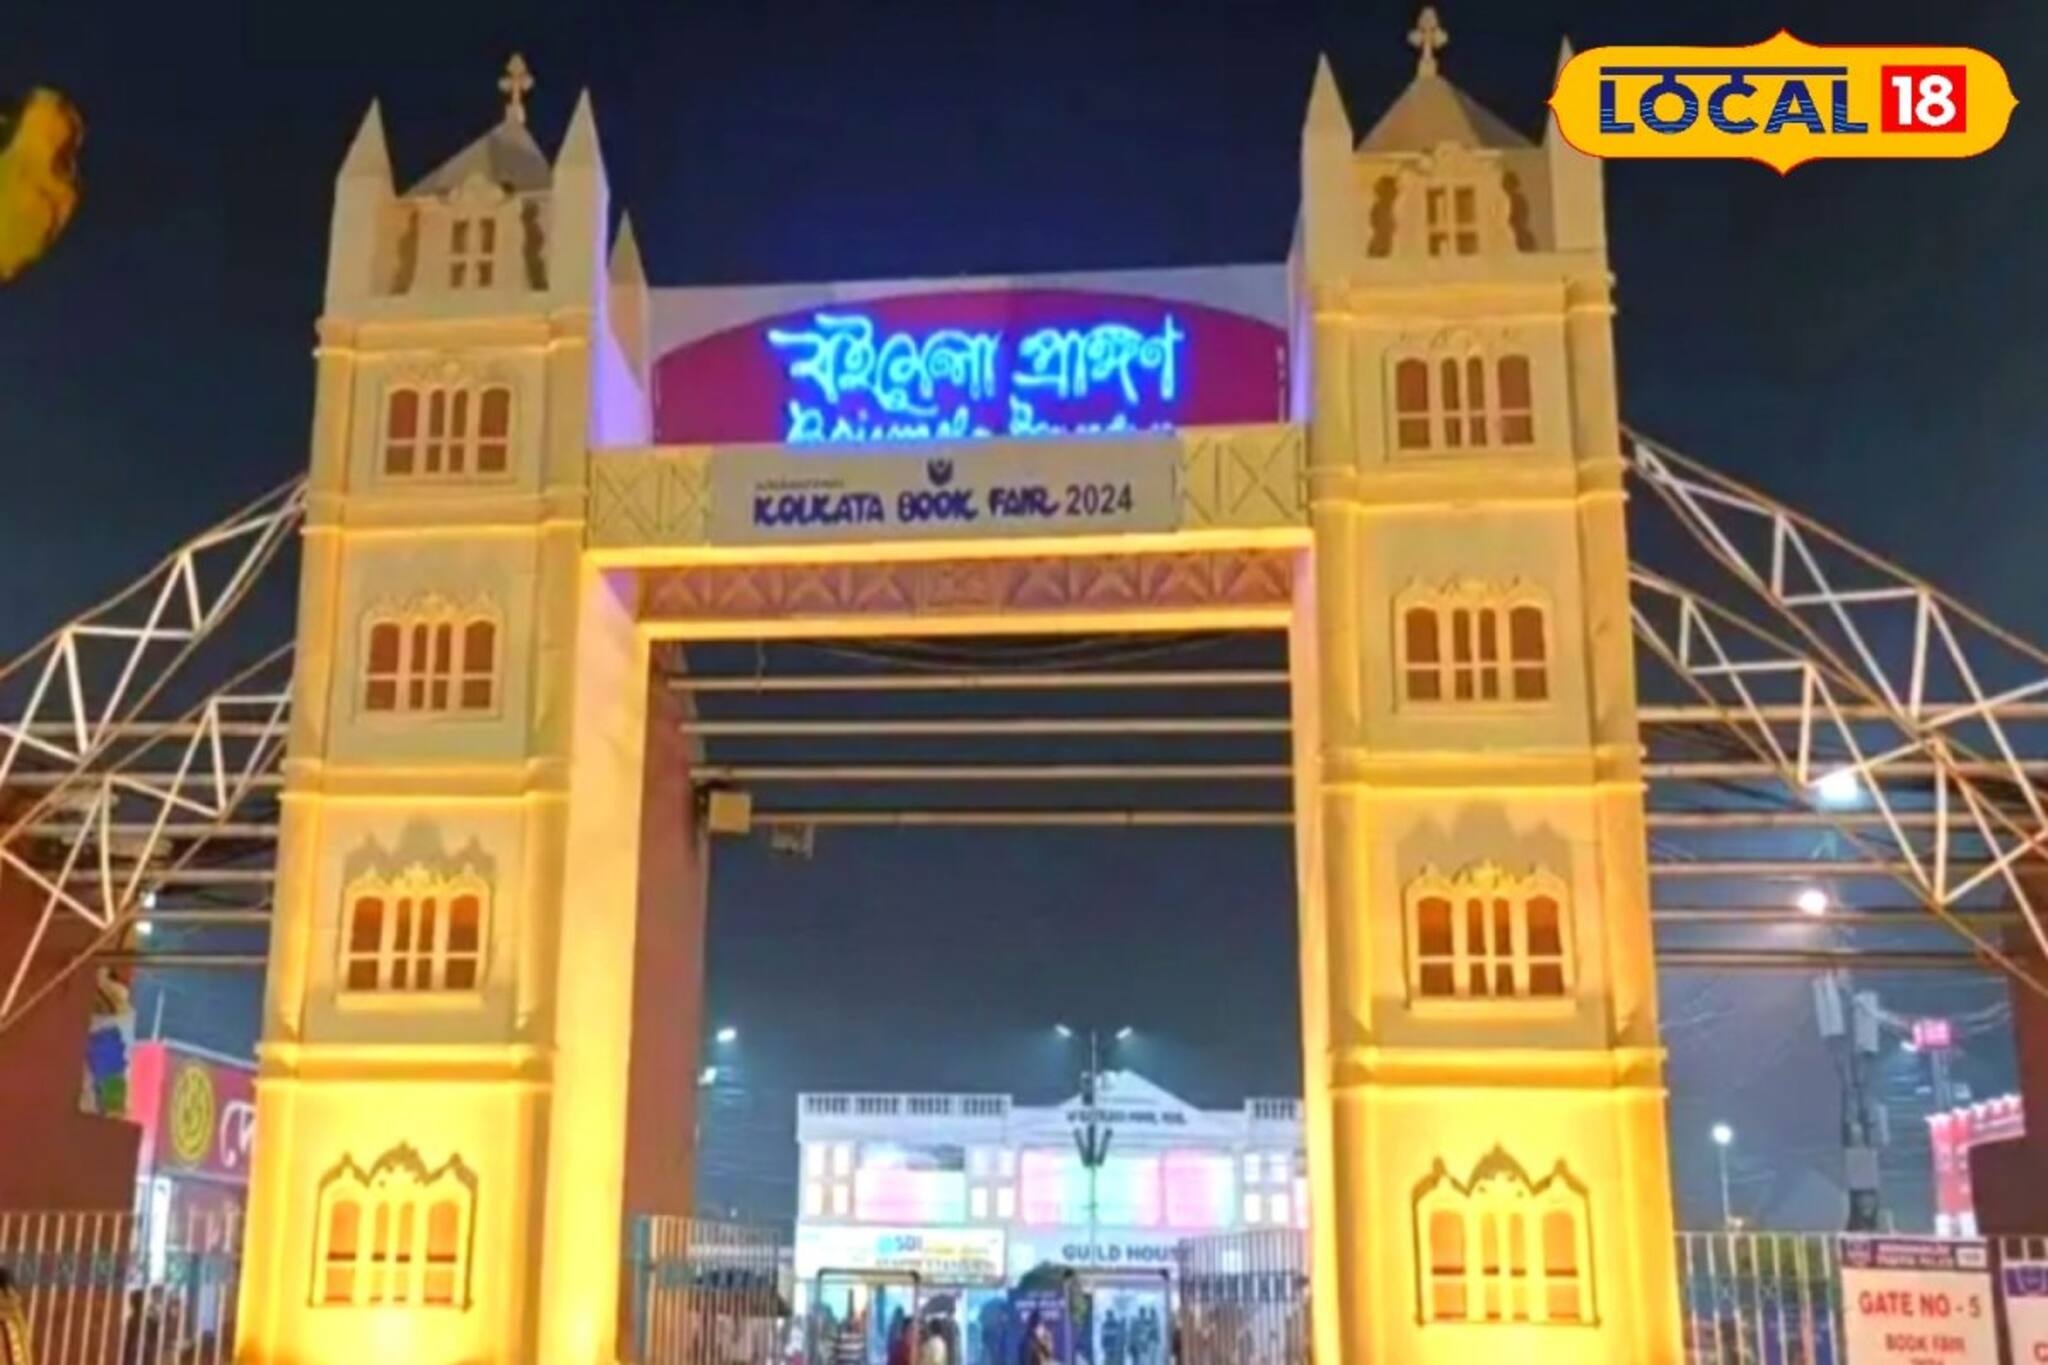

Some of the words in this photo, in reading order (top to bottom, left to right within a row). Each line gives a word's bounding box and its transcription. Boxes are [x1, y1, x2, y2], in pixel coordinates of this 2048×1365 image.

[754, 492, 885, 526] KOLKATA
[897, 489, 979, 523] BOOK
[987, 485, 1061, 517] FAIR
[1064, 482, 1133, 516] 2024
[1126, 1244, 1192, 1262] HOU
[1858, 1290, 1915, 1317] GATE
[1919, 1293, 1951, 1317] NO
[1968, 1296, 1982, 1319] 5
